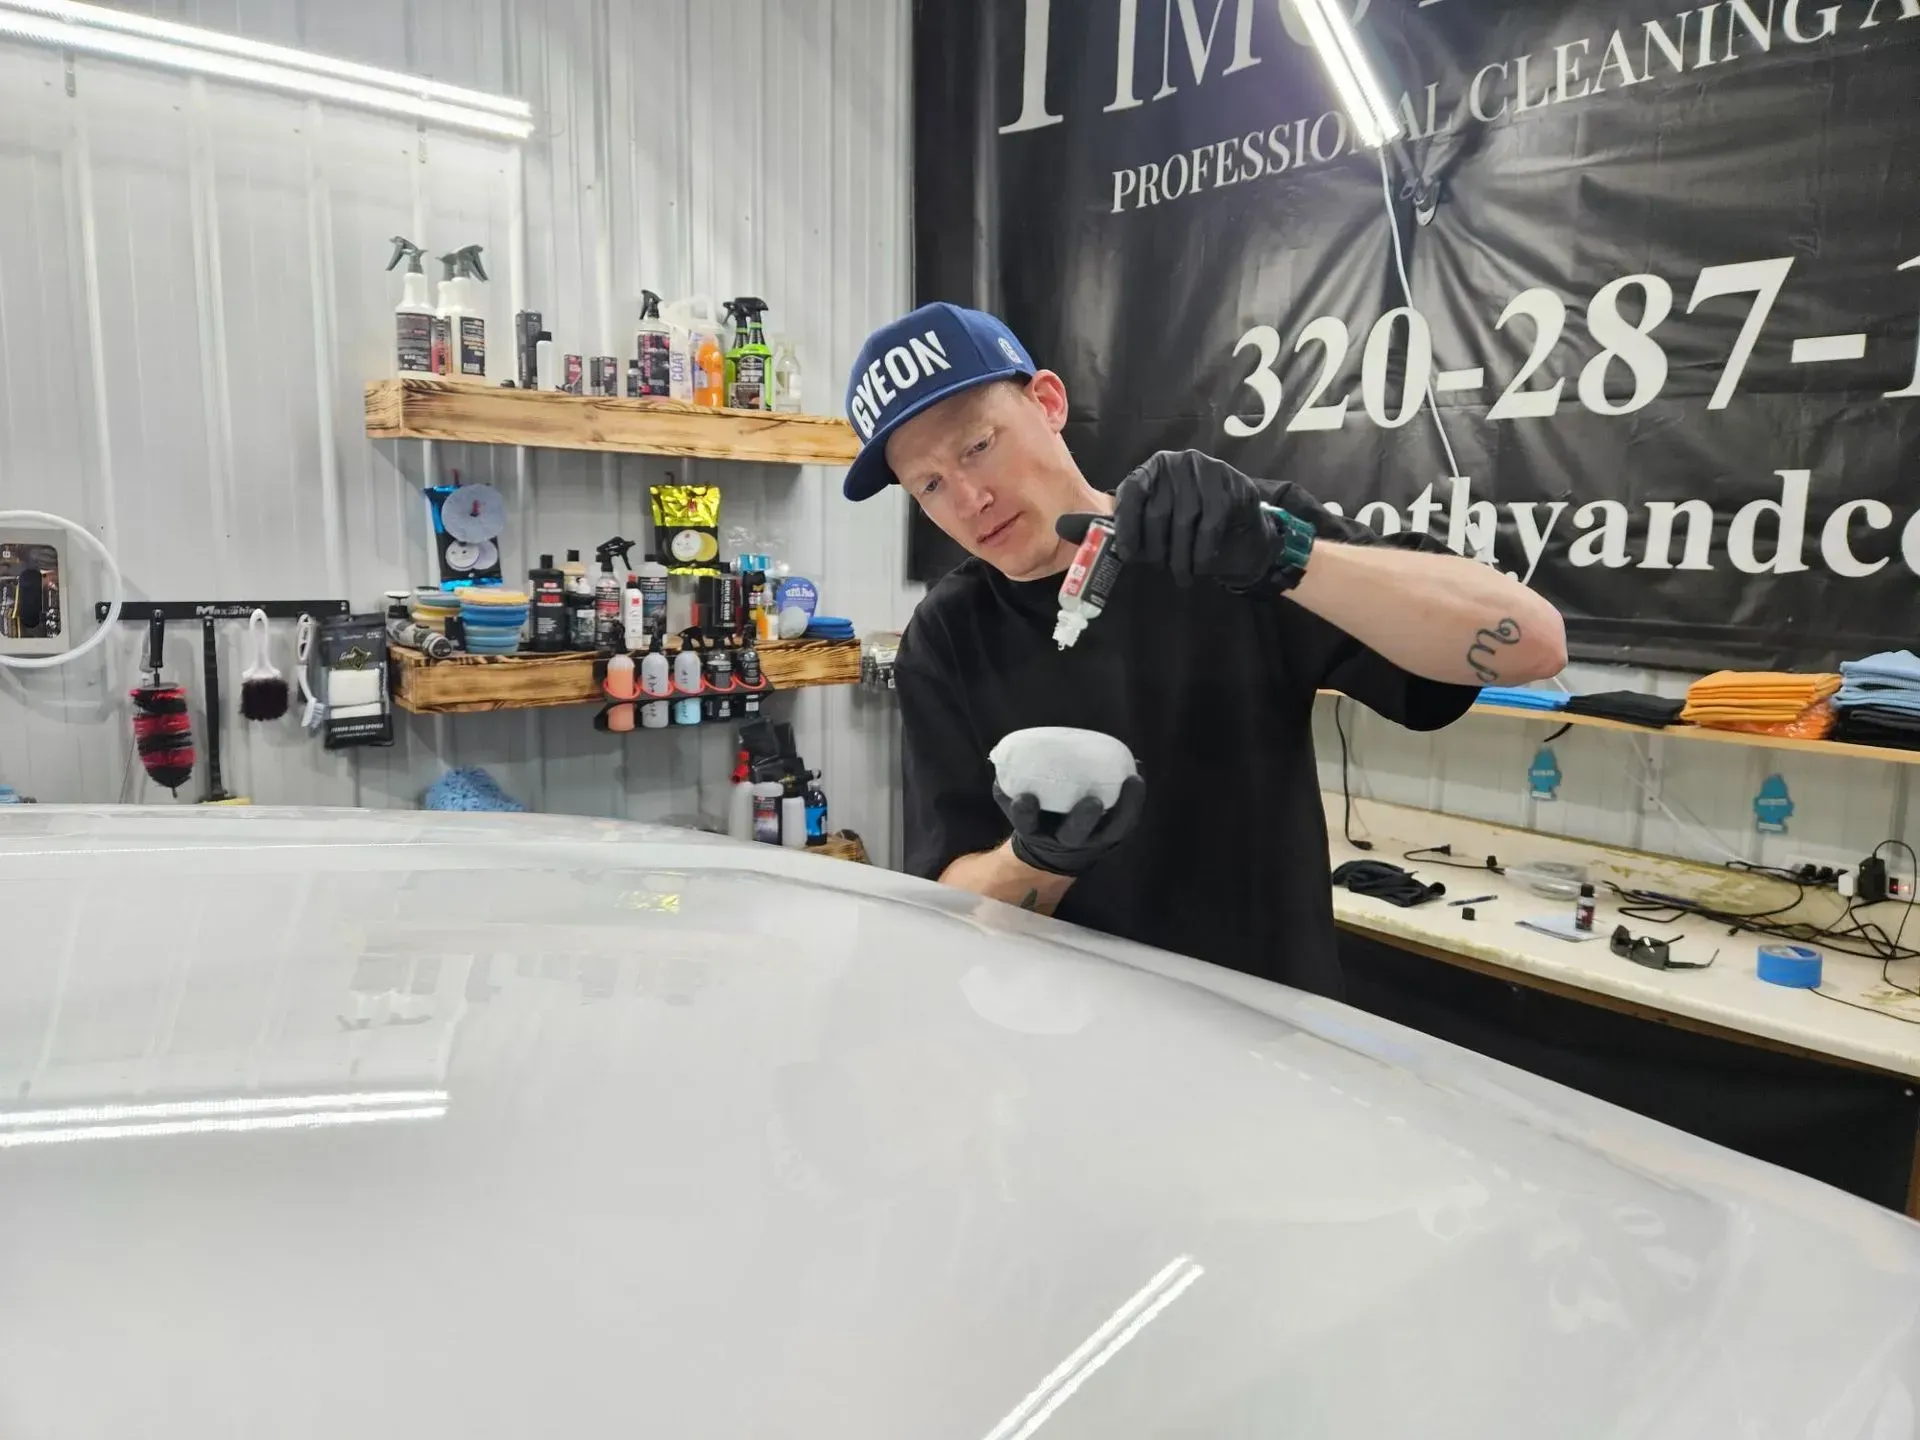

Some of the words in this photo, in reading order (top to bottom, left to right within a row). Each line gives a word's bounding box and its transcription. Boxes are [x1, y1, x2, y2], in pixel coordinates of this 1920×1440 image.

[1469, 0, 1843, 122] CLEANING
[852, 331, 952, 439] GYEON
[1322, 469, 1920, 584] othyandc
